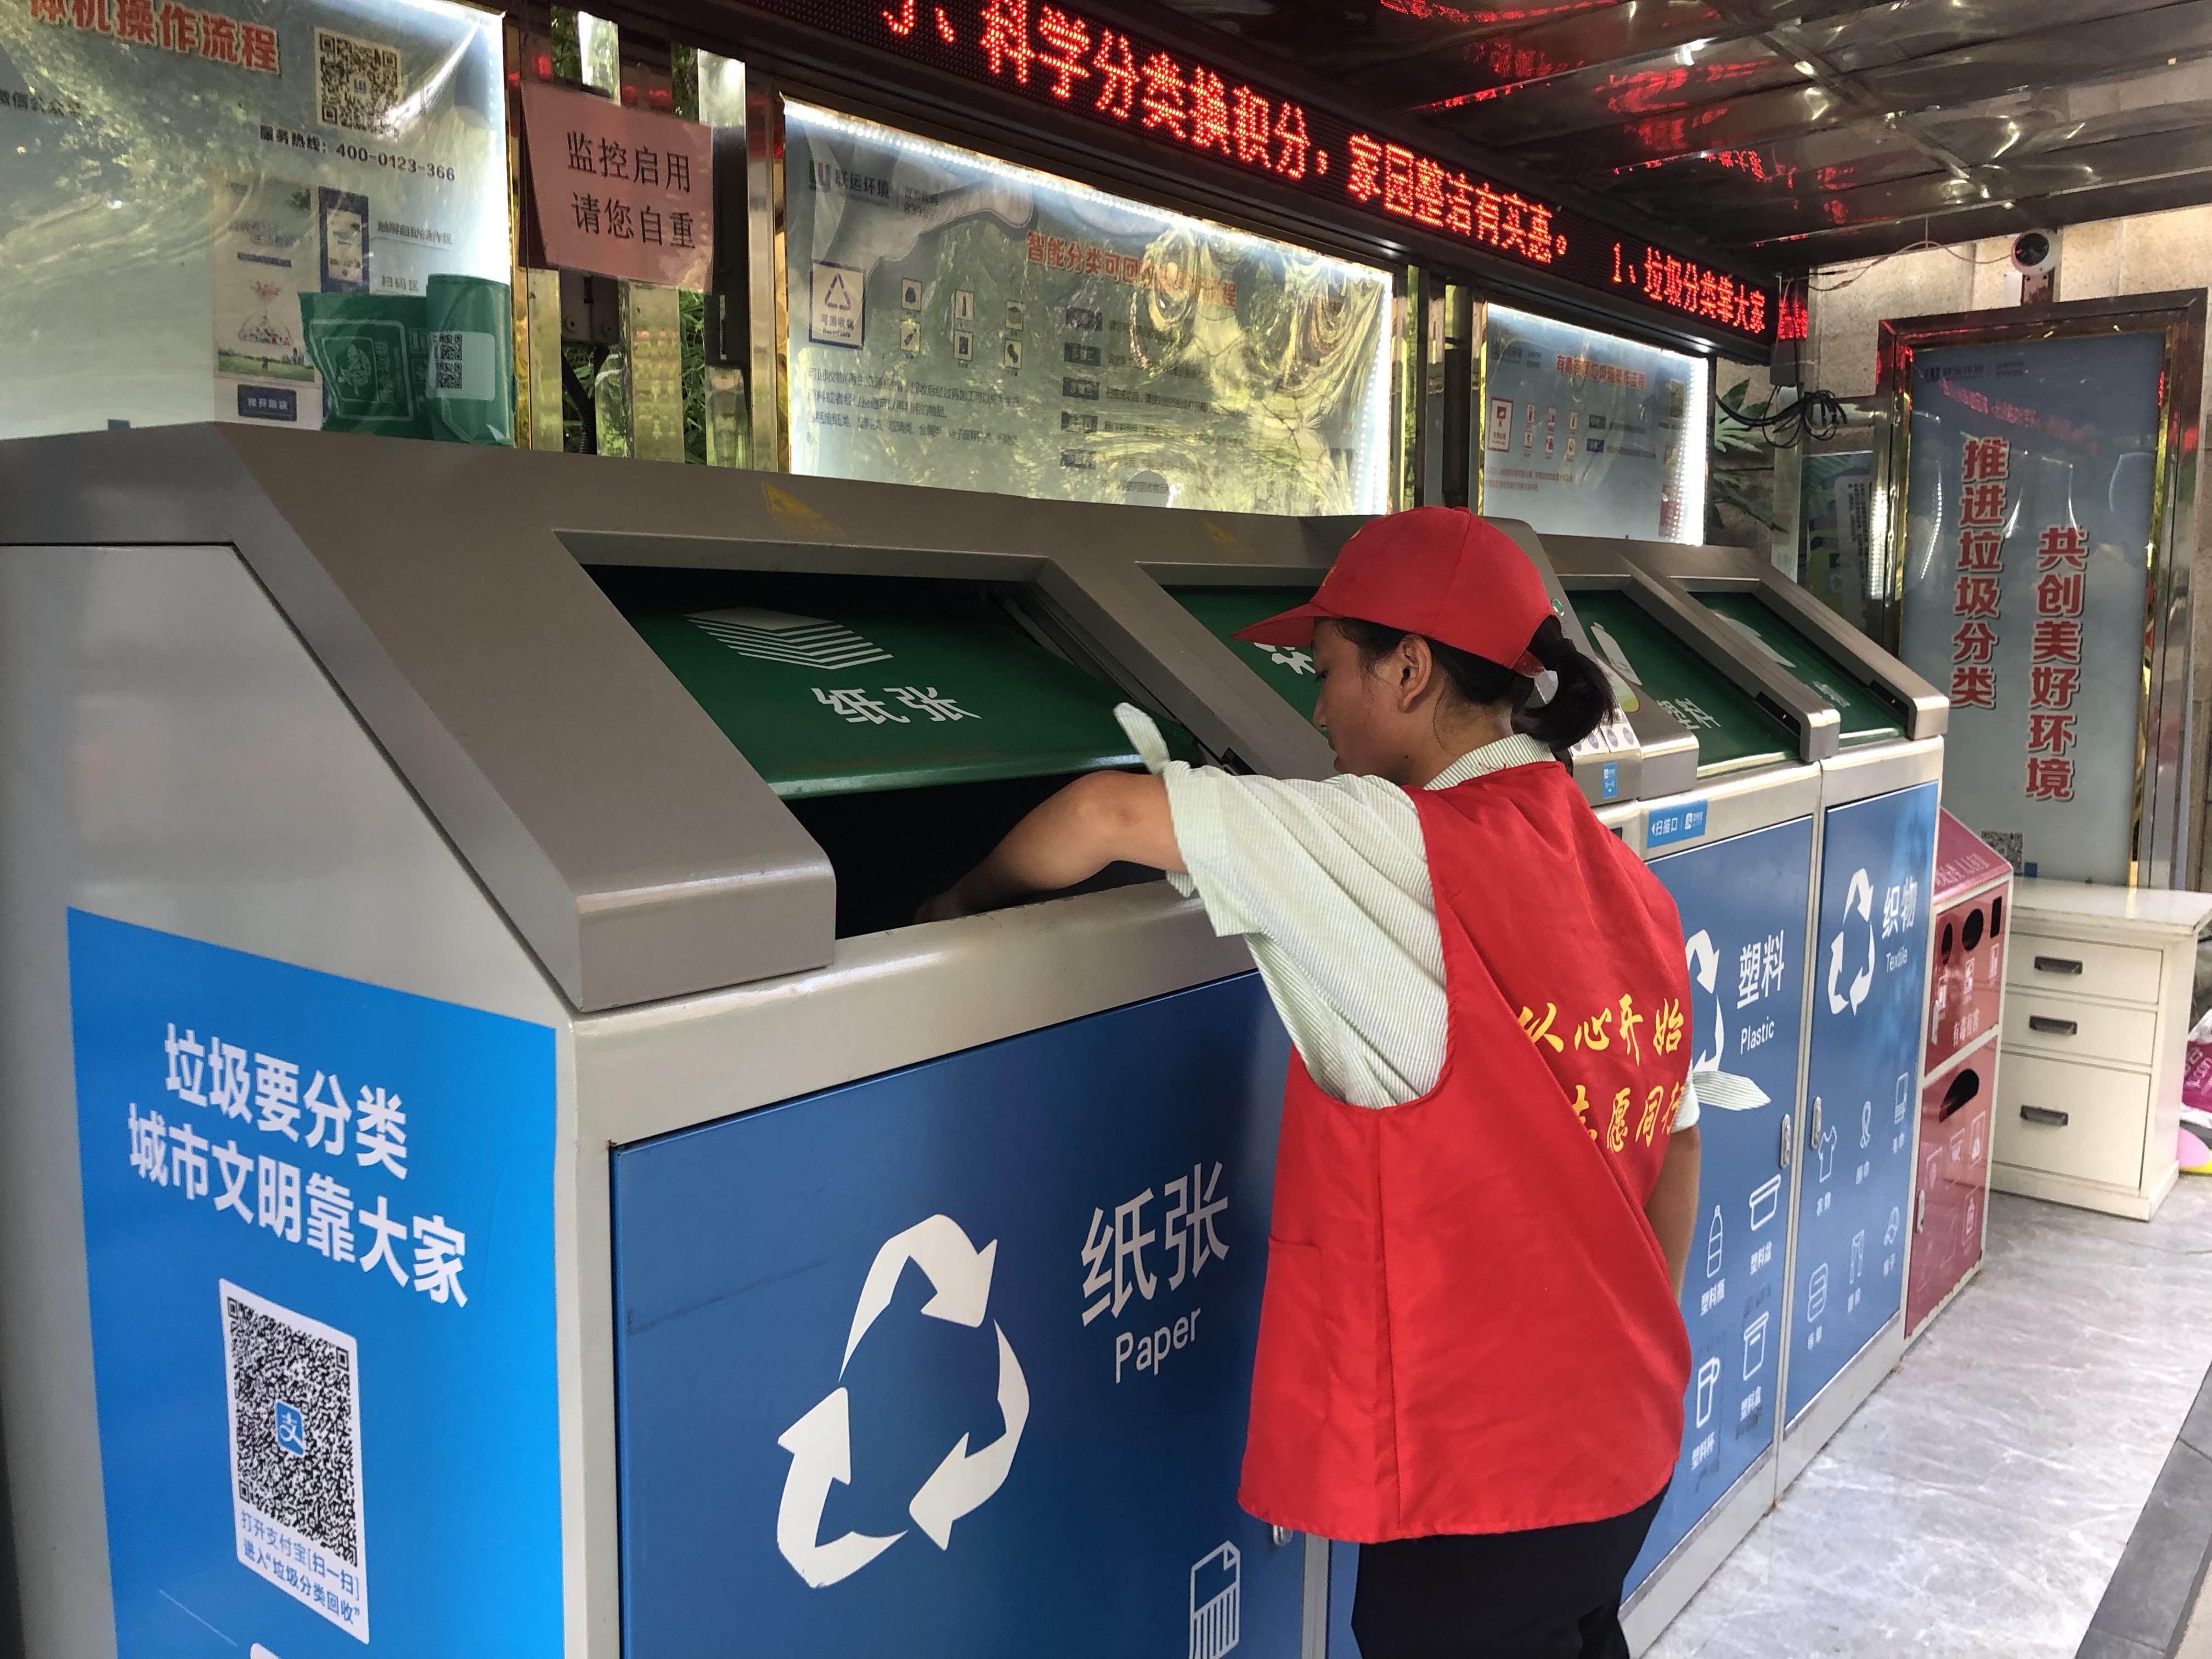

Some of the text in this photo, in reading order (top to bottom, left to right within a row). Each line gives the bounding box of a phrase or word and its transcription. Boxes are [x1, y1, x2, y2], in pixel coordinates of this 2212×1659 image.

[567, 130, 691, 193] 监控启用
[571, 191, 696, 249] 请您自重
[820, 313, 855, 331] 可回收物
[1951, 437, 2011, 709] 推进垃圾分类
[2025, 526, 2090, 802] 共创美好环境
[811, 686, 982, 725] 纸张
[1882, 875, 1918, 940] 织物
[1736, 929, 1785, 1010] 塑料
[1516, 992, 1685, 1066] 从心开始
[1740, 1015, 1775, 1056] Plastic
[165, 1023, 408, 1180] 垃圾要分类
[128, 1102, 469, 1308] 城市文明靠大家
[1081, 1160, 1230, 1327] 纸张
[1115, 1307, 1201, 1384] Paper
